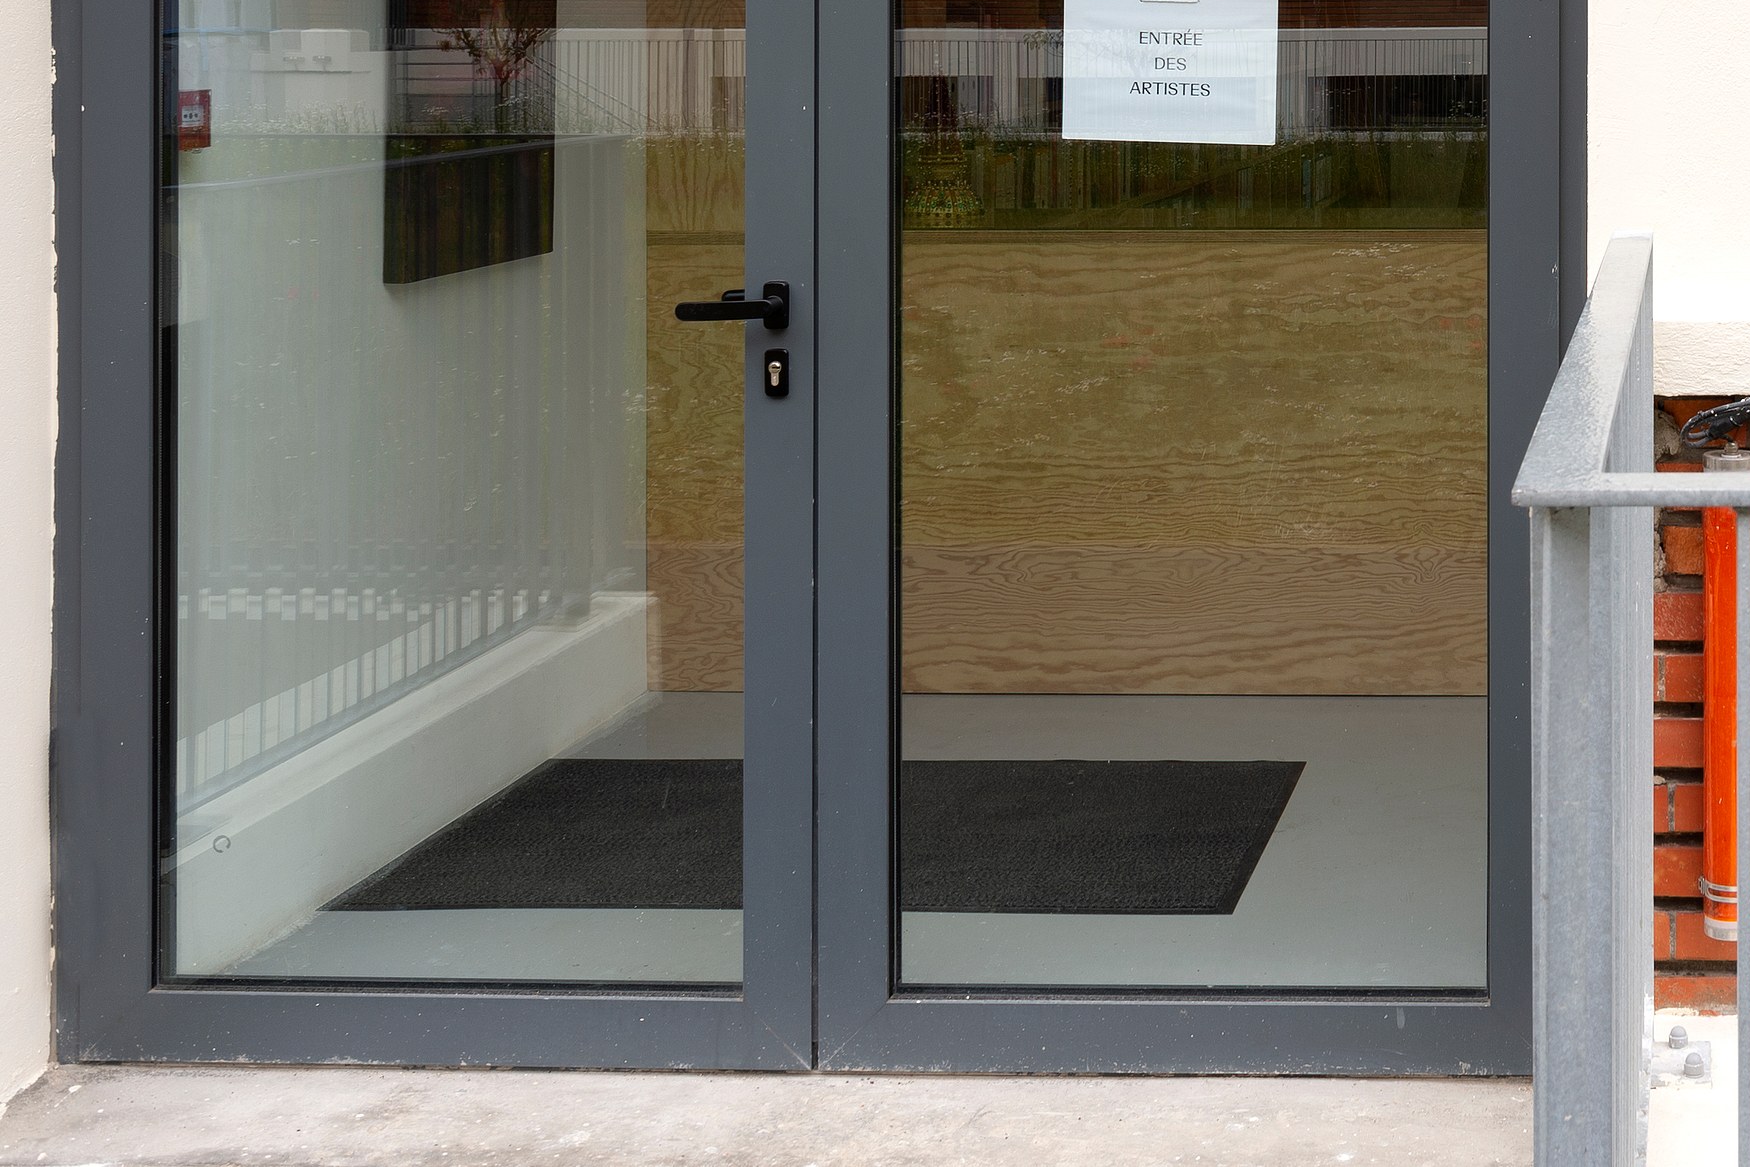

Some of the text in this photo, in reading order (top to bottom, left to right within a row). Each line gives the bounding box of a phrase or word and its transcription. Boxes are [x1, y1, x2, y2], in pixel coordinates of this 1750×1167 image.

[1139, 29, 1203, 46] ENTRÉE
[1154, 56, 1187, 71] DES
[1129, 81, 1211, 97] ARTISTES
